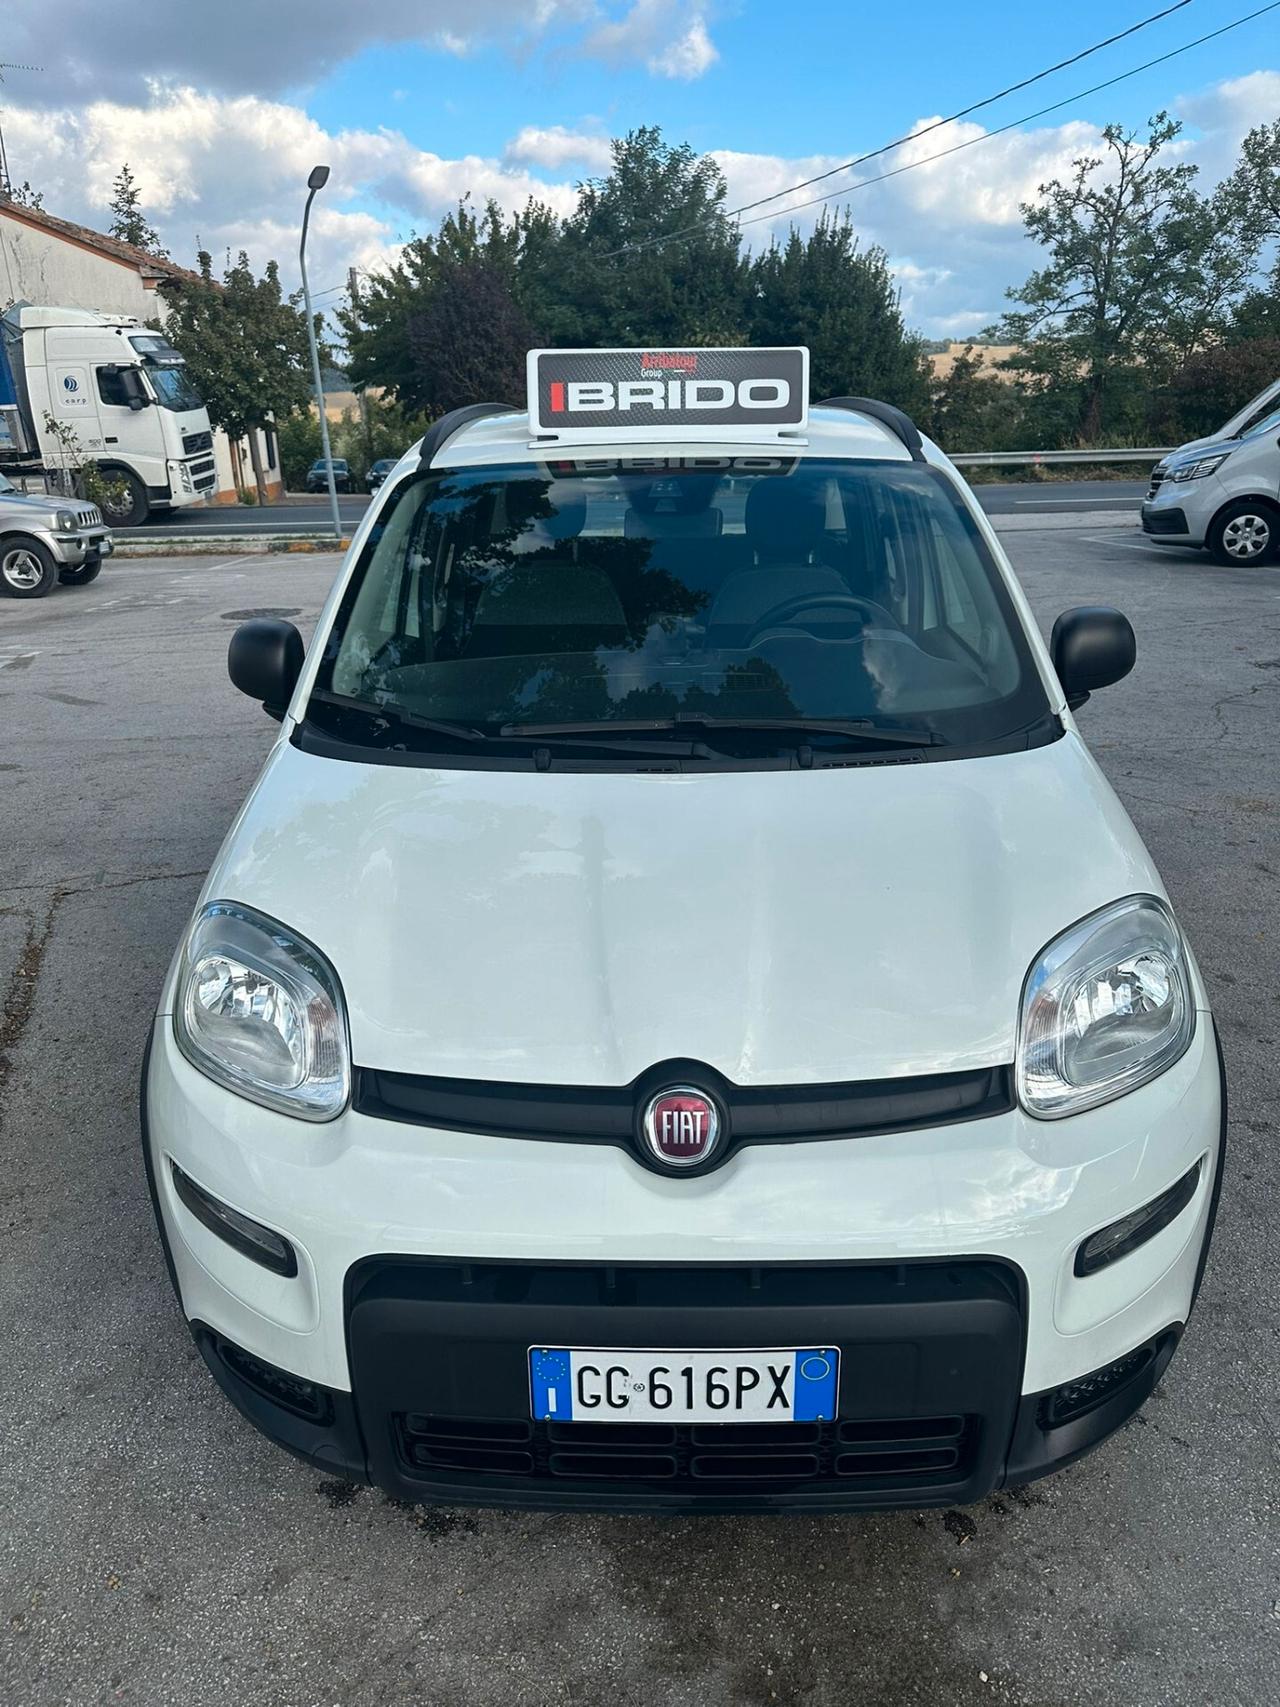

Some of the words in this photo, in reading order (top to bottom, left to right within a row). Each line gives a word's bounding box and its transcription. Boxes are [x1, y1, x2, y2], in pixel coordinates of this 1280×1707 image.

[641, 368, 663, 379] Group
[662, 1111, 705, 1144] FIAT
[577, 1366, 630, 1409] GG
[649, 1365, 791, 1409] 616PX
